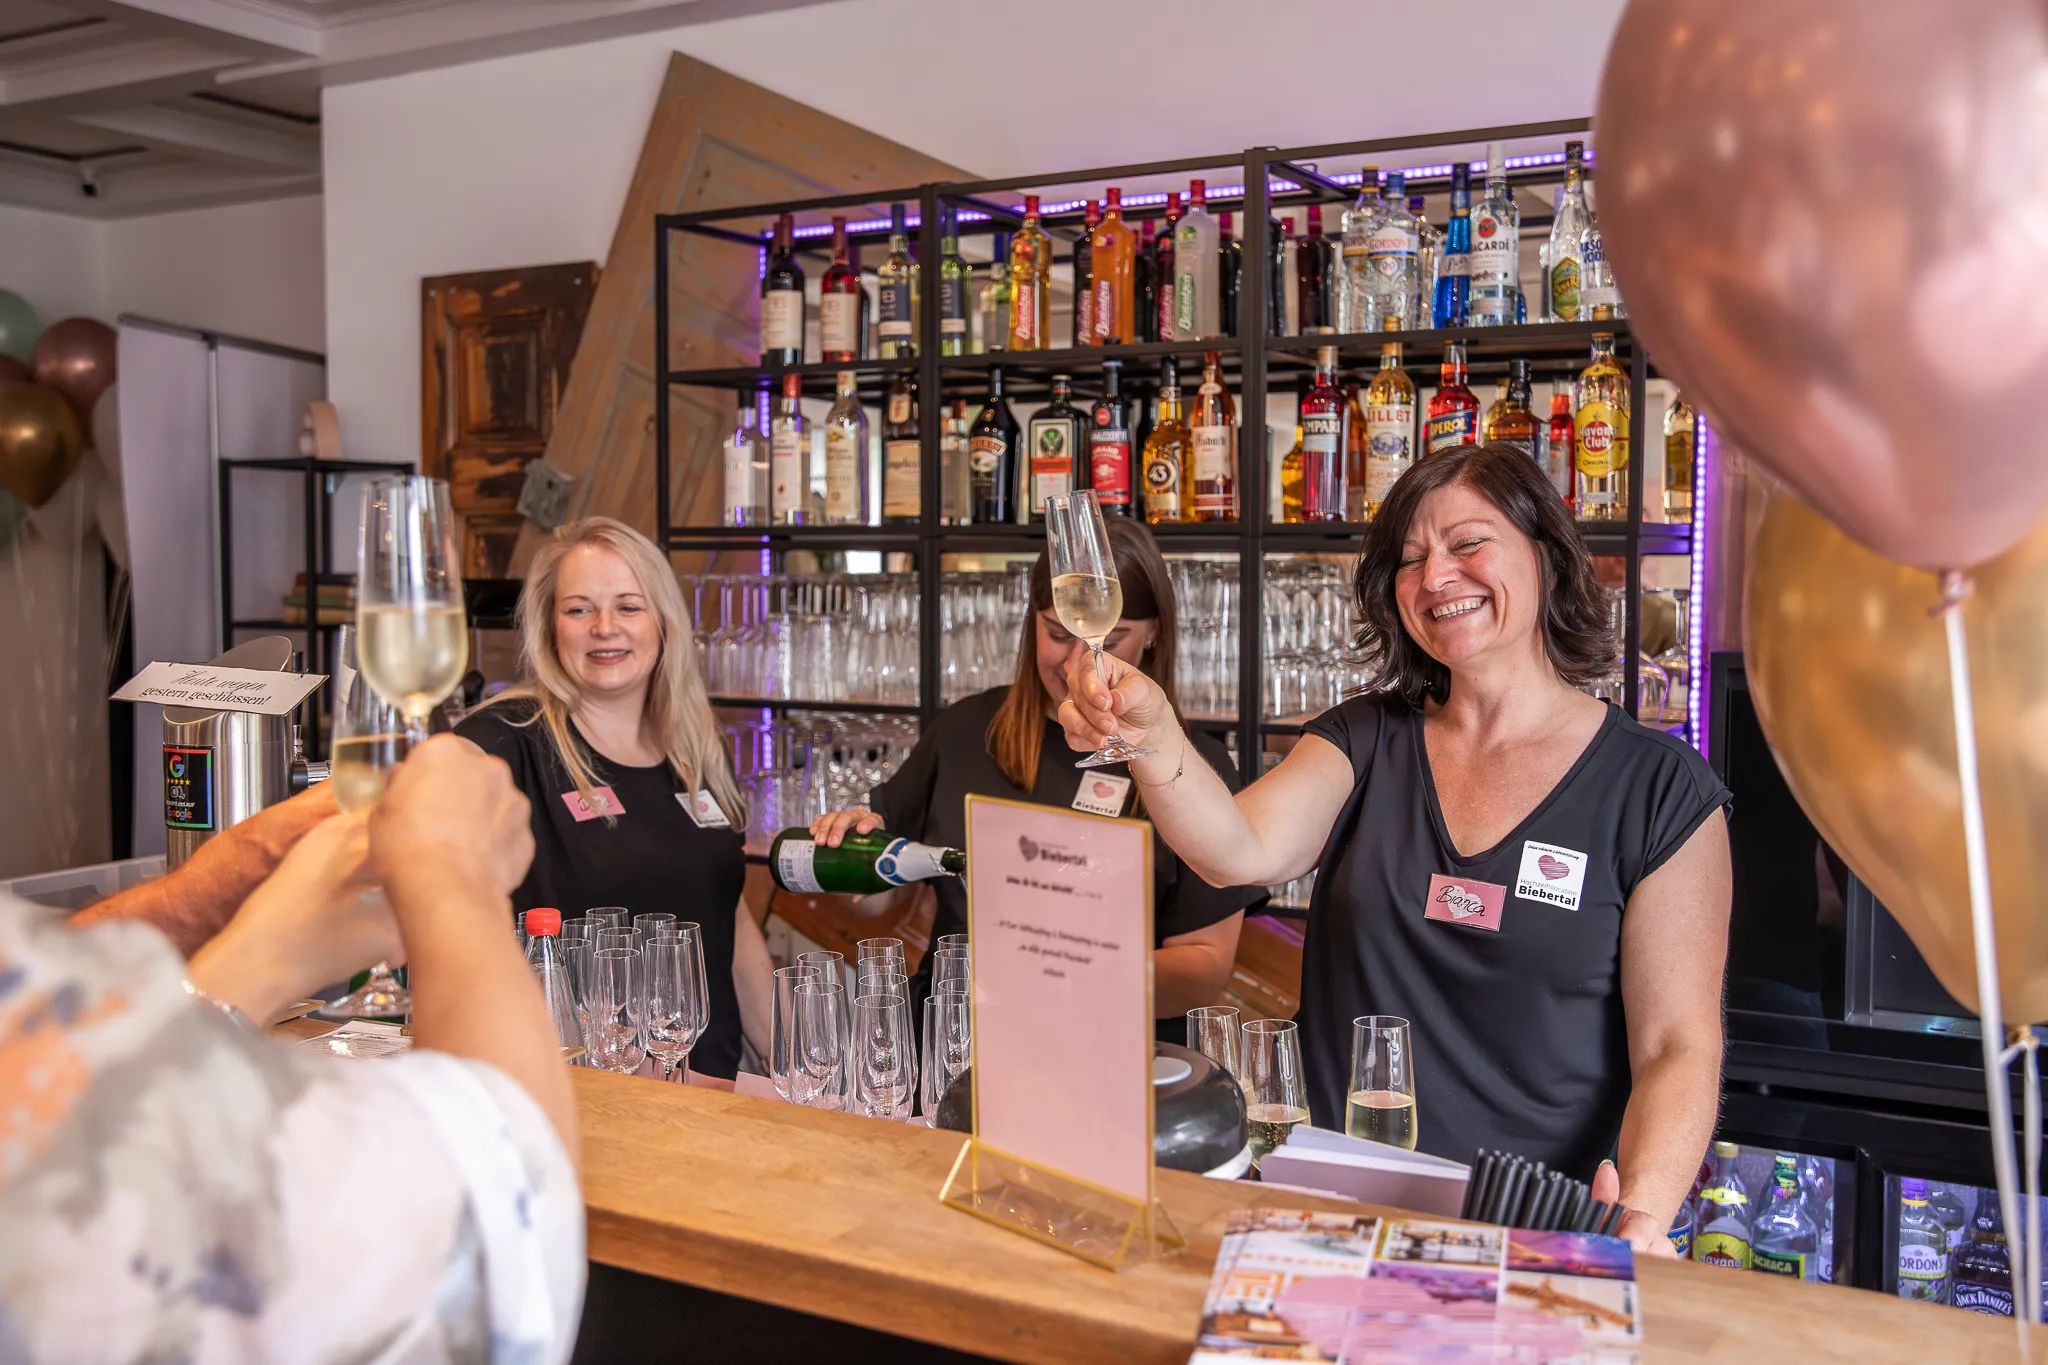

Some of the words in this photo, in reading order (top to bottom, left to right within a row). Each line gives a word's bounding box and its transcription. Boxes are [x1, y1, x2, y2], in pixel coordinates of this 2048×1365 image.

[1585, 436, 1610, 448] Club
[170, 670, 219, 687] Heute
[216, 680, 268, 694] wegen
[139, 687, 189, 698] gestern
[185, 690, 272, 706] geschlossen!
[1518, 885, 1577, 907] Biebertal
[1519, 878, 1578, 897] Hochzeitslocation
[1435, 885, 1486, 917] Bianca
[1699, 1252, 1743, 1268] Havana
[1955, 1291, 1978, 1307] JACK
[1978, 1290, 2014, 1315] DANIEL'S
